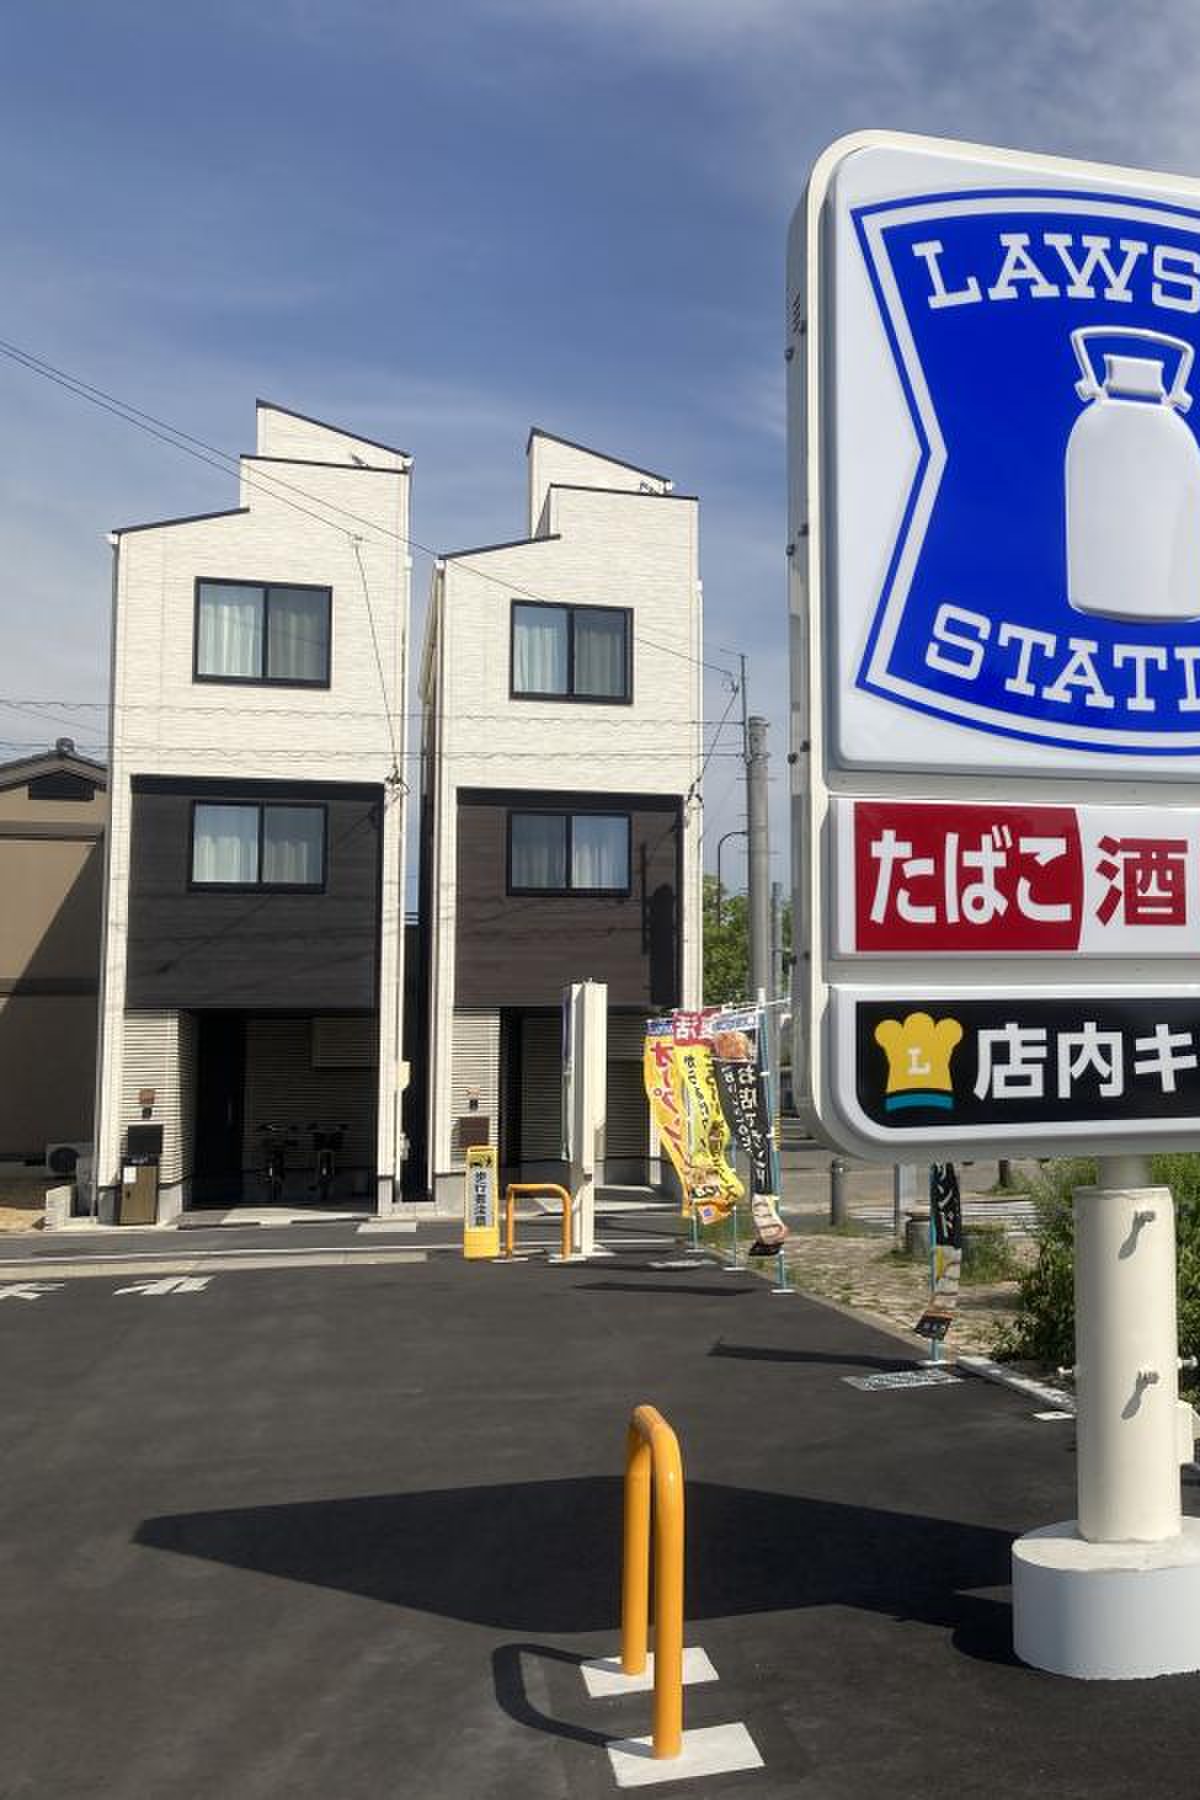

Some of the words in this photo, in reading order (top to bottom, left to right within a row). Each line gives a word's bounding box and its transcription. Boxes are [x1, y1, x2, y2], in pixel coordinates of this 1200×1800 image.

[870, 824, 1072, 925] たばこ
[1095, 834, 1189, 927] 酒
[907, 1046, 931, 1076] L
